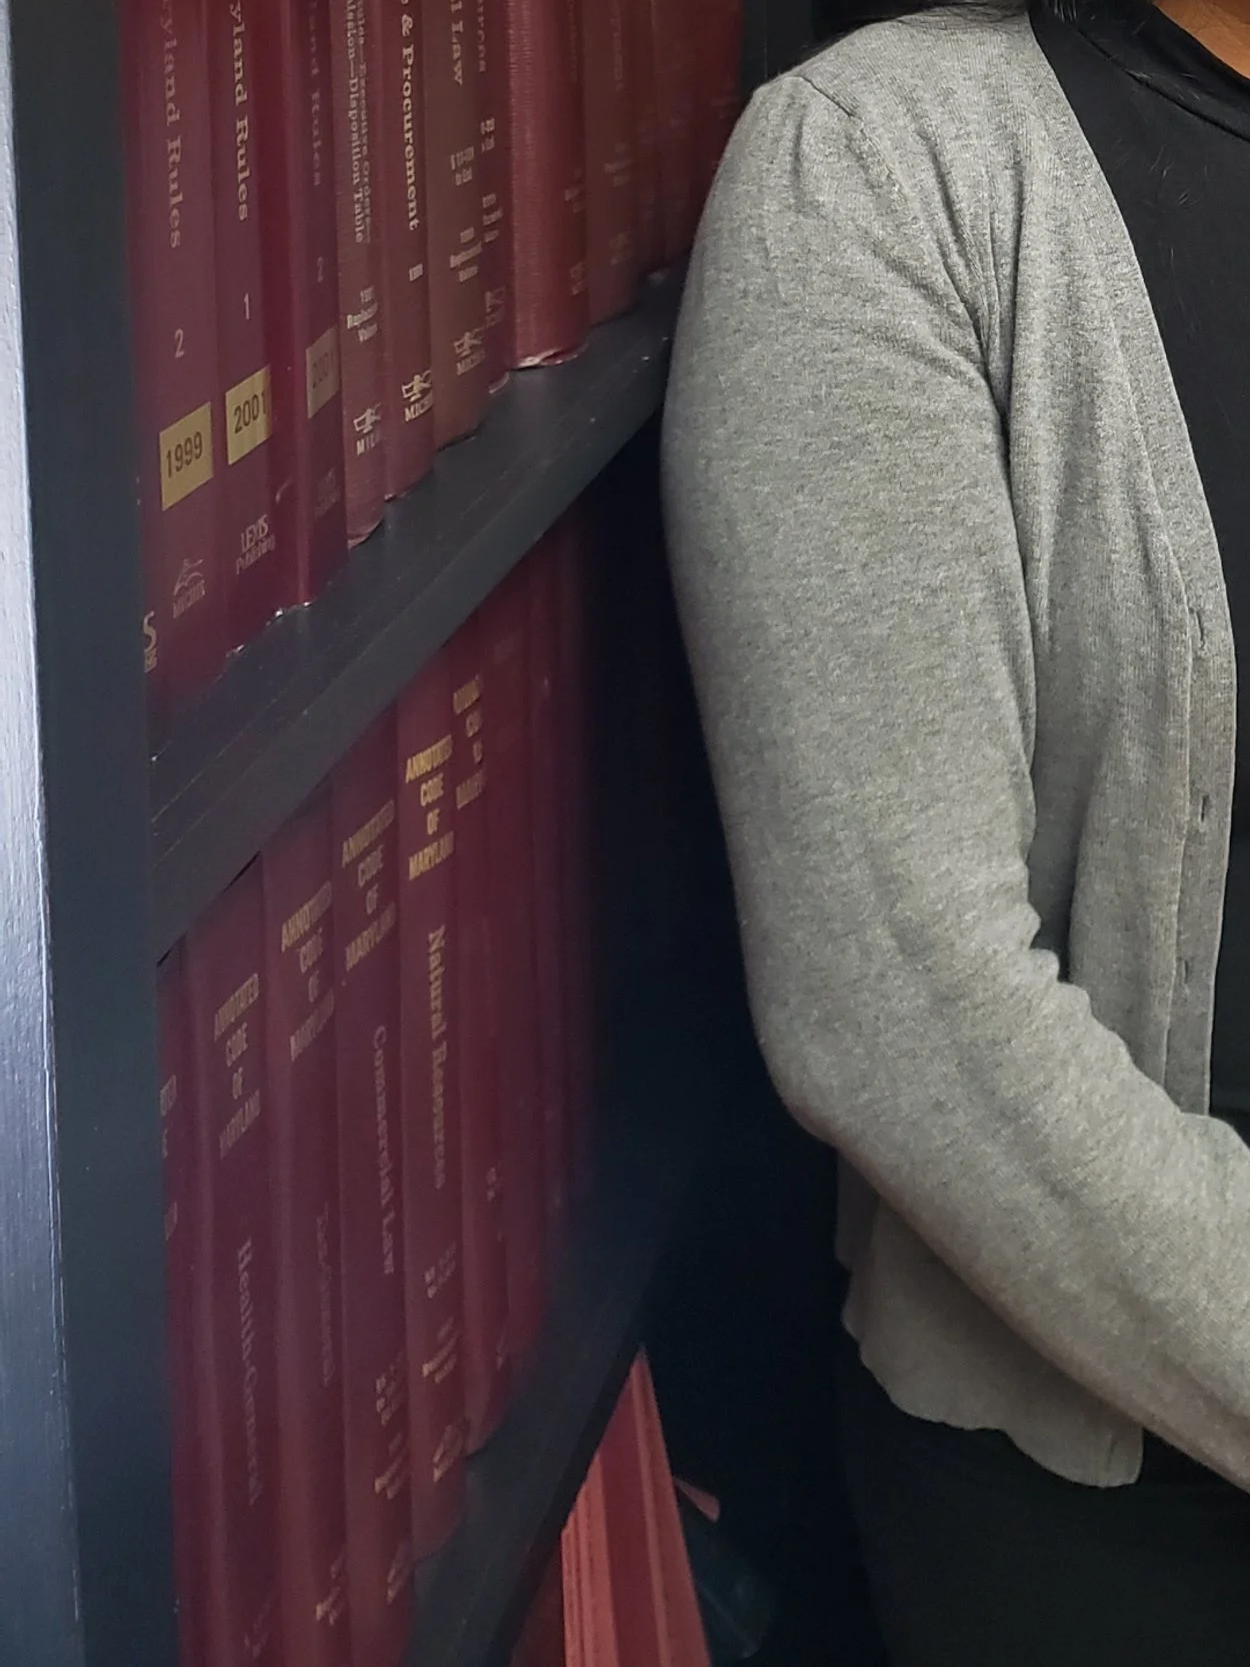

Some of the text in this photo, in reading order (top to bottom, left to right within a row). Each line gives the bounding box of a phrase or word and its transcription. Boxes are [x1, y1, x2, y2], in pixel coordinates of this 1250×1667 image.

[402, 14, 412, 35] &
[403, 45, 419, 230] Procurement
[237, 117, 249, 220] Rules
[235, 392, 265, 433] 2001
[167, 432, 202, 477] 1999
